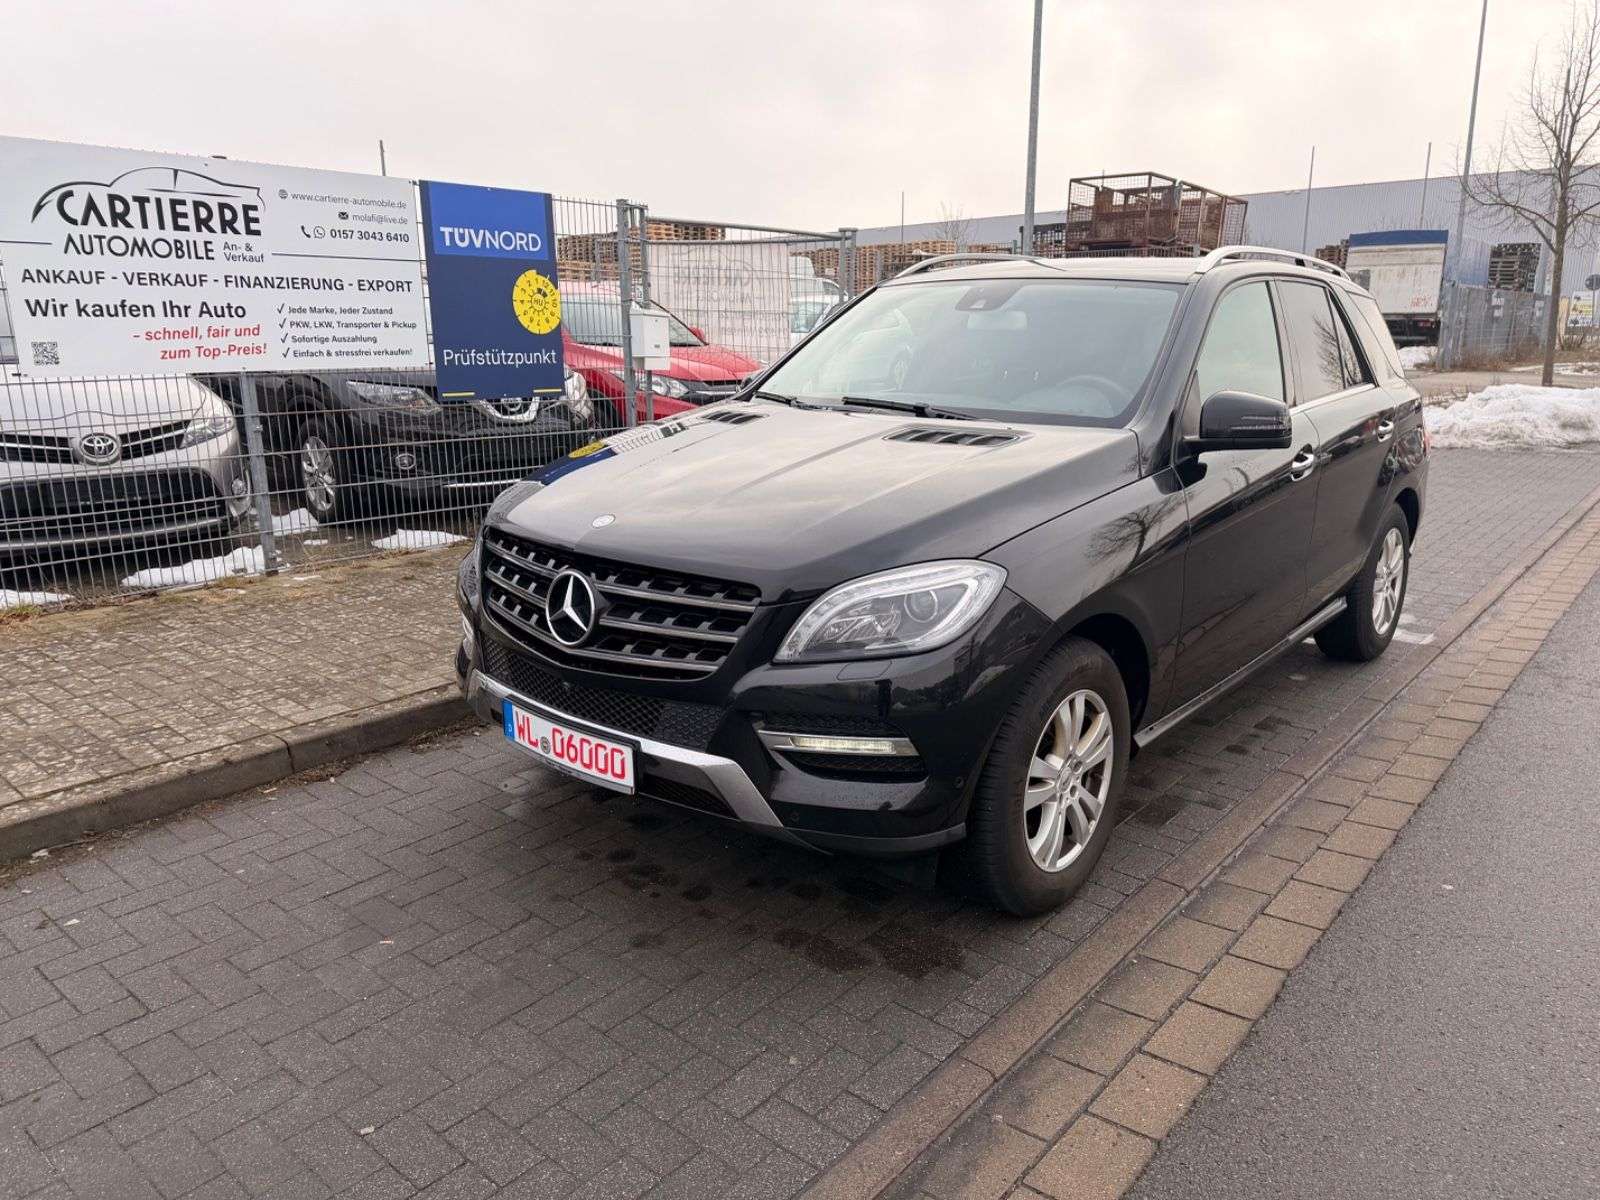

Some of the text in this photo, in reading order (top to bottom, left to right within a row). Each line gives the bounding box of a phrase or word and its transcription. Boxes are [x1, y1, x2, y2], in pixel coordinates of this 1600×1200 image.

[291, 192, 407, 209] www.cartierre-automobile.de
[57, 190, 262, 236] CARTIERRE
[330, 228, 410, 242] 0157 3043 6410
[64, 233, 214, 260] AUTOMOBILE
[223, 241, 253, 252] An- &
[223, 252, 264, 263] Verkauf
[21, 269, 105, 284] ANKAUF
[122, 272, 208, 288] VERKAUF
[224, 275, 344, 291] FINANZIERUNG
[357, 280, 413, 293] EXPORT
[24, 298, 247, 318] Wir kaufen Ihr Auto
[288, 307, 307, 315] Jede
[309, 307, 337, 316] Marke,
[362, 307, 393, 315] Zustand
[145, 326, 203, 341] schnell,
[207, 326, 231, 339] fair
[234, 324, 260, 338] und
[290, 321, 417, 331] PKW, LKW, Transporter & Pickup
[291, 335, 378, 344] Sofortige Auszahlung
[161, 343, 267, 360] zum Top-Preis!
[293, 349, 324, 358] Einfach
[335, 348, 372, 357] stressfrei
[373, 348, 413, 356] verkaufen!
[443, 348, 558, 368] Prüfstützpunkt
[515, 711, 626, 780] WL 06000
